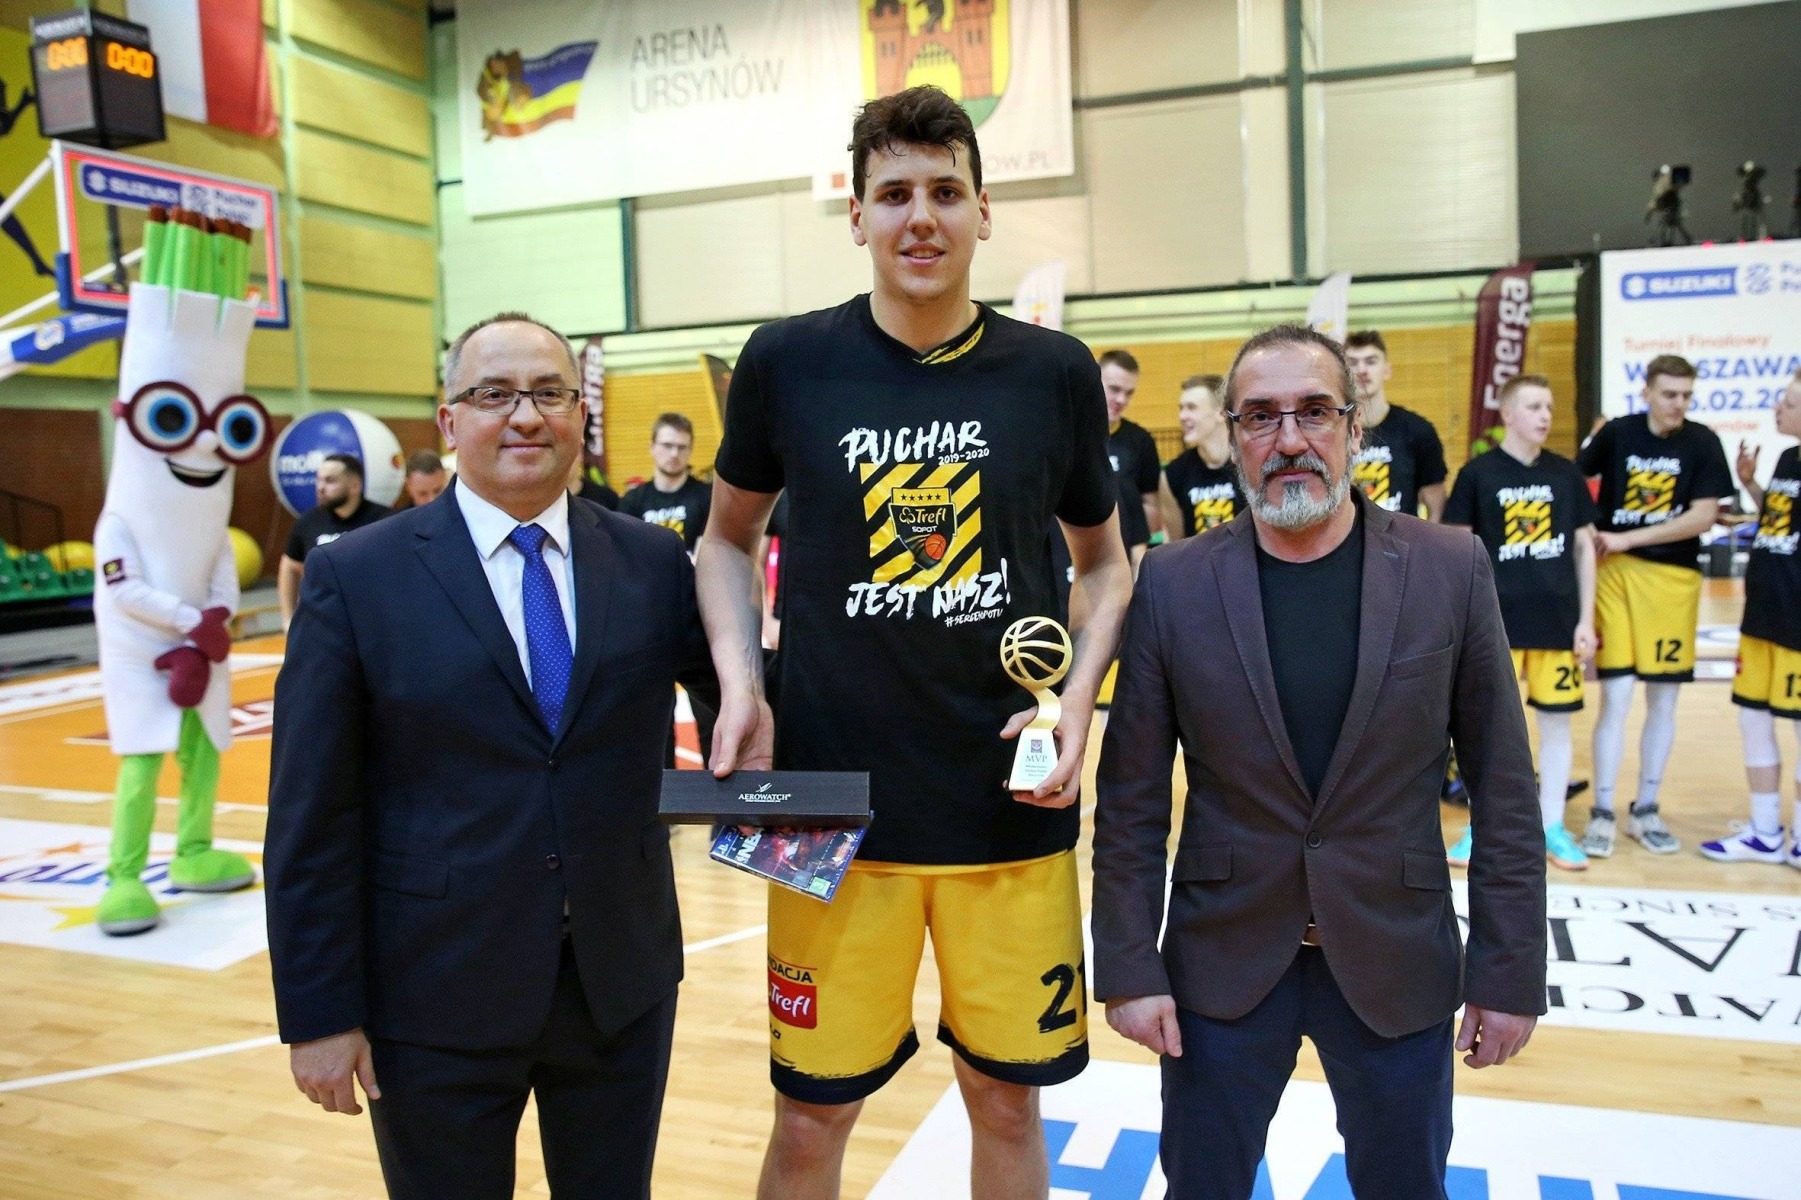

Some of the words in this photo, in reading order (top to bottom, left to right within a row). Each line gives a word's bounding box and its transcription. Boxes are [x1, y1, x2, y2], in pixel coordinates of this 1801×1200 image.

[107, 41, 154, 79] 0:00
[630, 23, 730, 71] ARENA
[631, 55, 785, 114] URSYNÓW
[1624, 354, 1801, 382] WSZAWA
[838, 420, 987, 473] PUCHAR
[938, 448, 990, 466] 2019-2020
[915, 508, 947, 525] Trefl
[846, 582, 927, 620] JEST
[932, 558, 1011, 618] NASZ!
[1655, 639, 1682, 662] 12
[1026, 755, 1047, 763] MVP
[738, 793, 788, 801] AEROWATCH
[771, 982, 811, 1017] Trefl
